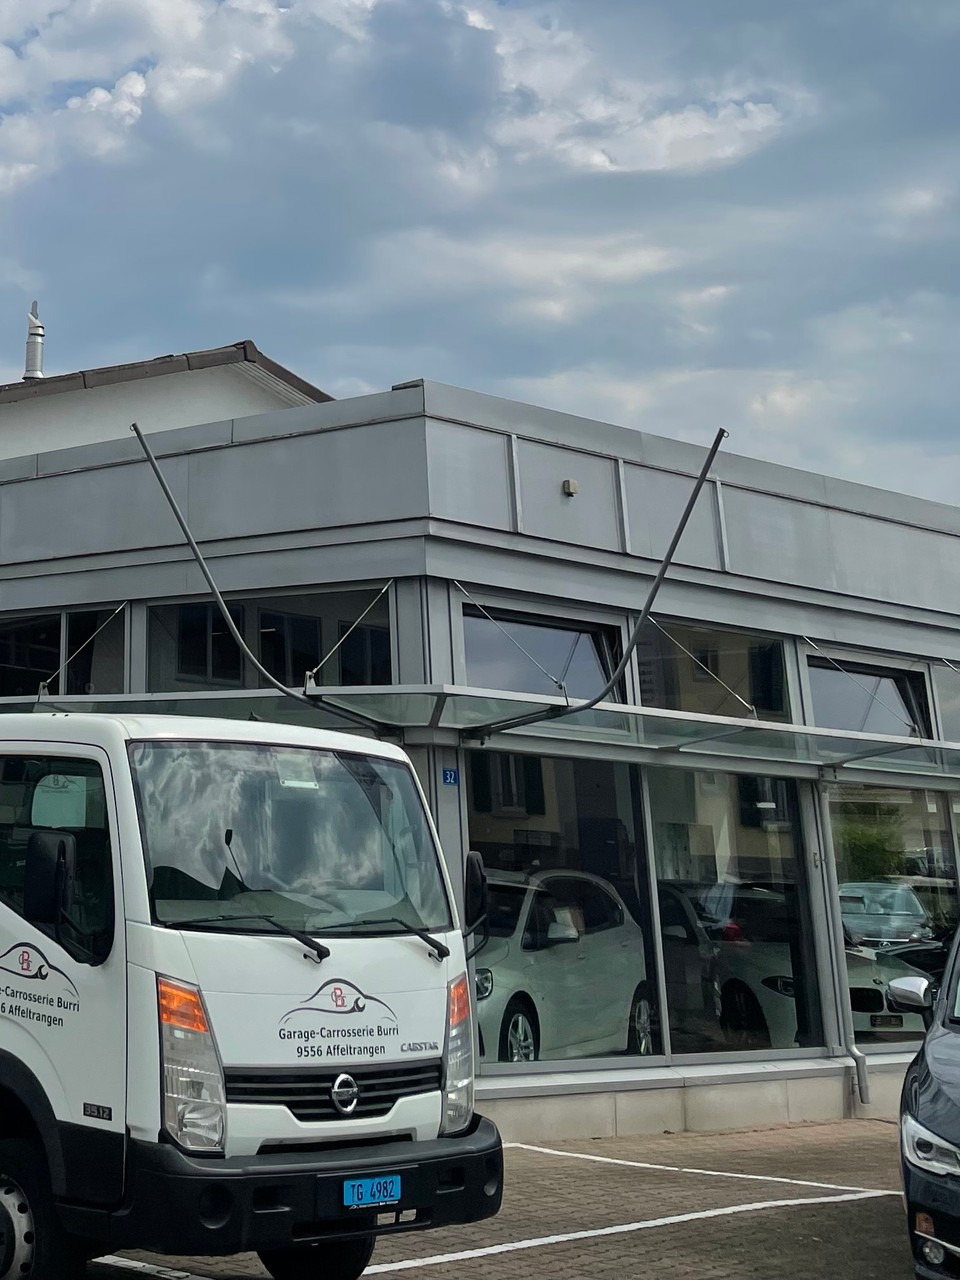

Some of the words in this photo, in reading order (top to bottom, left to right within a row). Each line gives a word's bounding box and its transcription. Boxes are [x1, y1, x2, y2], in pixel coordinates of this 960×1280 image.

[446, 771, 455, 783] 32
[57, 997, 80, 1012] Burri
[8, 1004, 64, 1027] Affeltrangen
[278, 1025, 375, 1042] Garage-Carrosserie
[377, 1025, 399, 1037] Burri
[296, 1045, 323, 1057] 9556
[326, 1044, 386, 1058] Affeltrangen
[351, 1183, 363, 1201] TG
[370, 1180, 395, 1200] 4982
